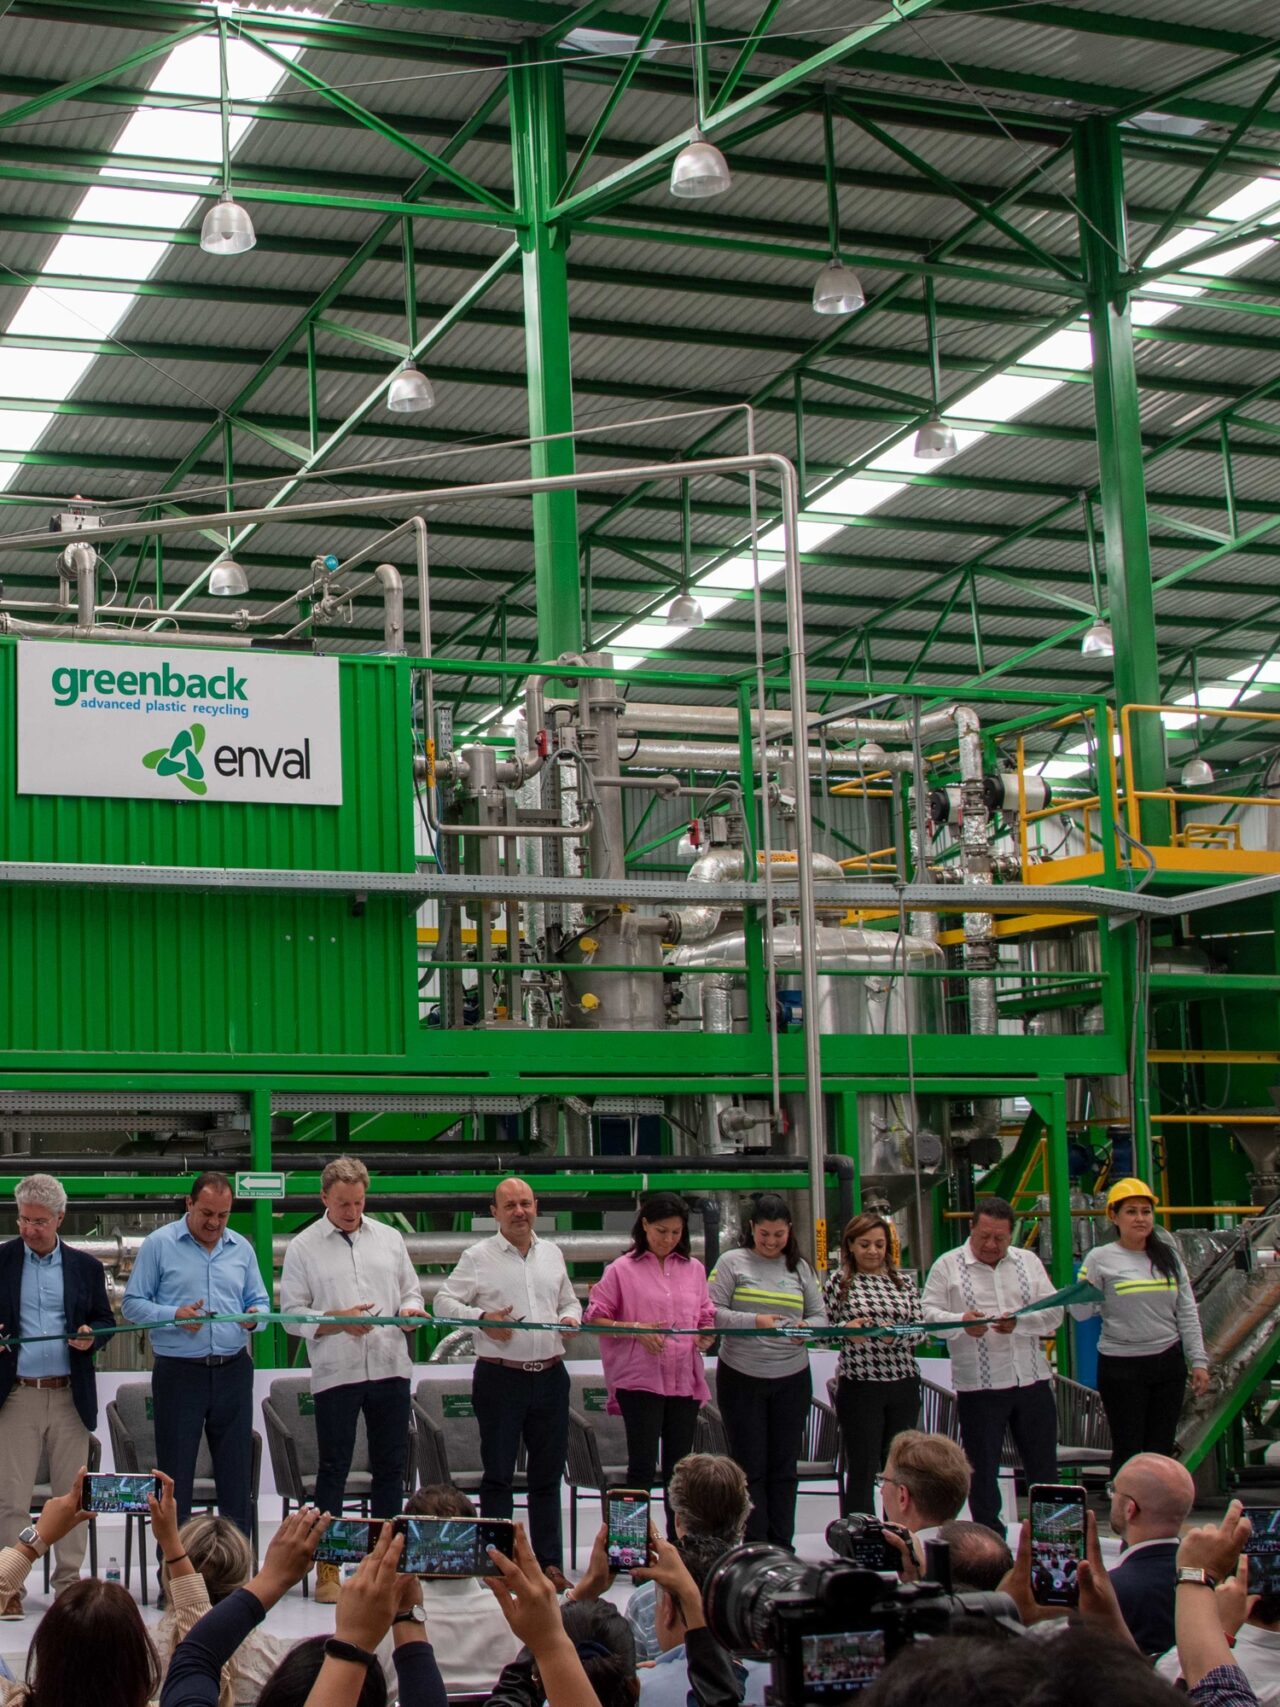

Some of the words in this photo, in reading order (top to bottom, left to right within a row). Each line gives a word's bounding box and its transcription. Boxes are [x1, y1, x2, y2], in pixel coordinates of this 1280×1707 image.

[52, 661, 248, 707] greenback
[81, 698, 141, 711] advanced
[146, 700, 187, 714] plastic
[192, 702, 250, 718] recycling
[214, 737, 311, 780] enval
